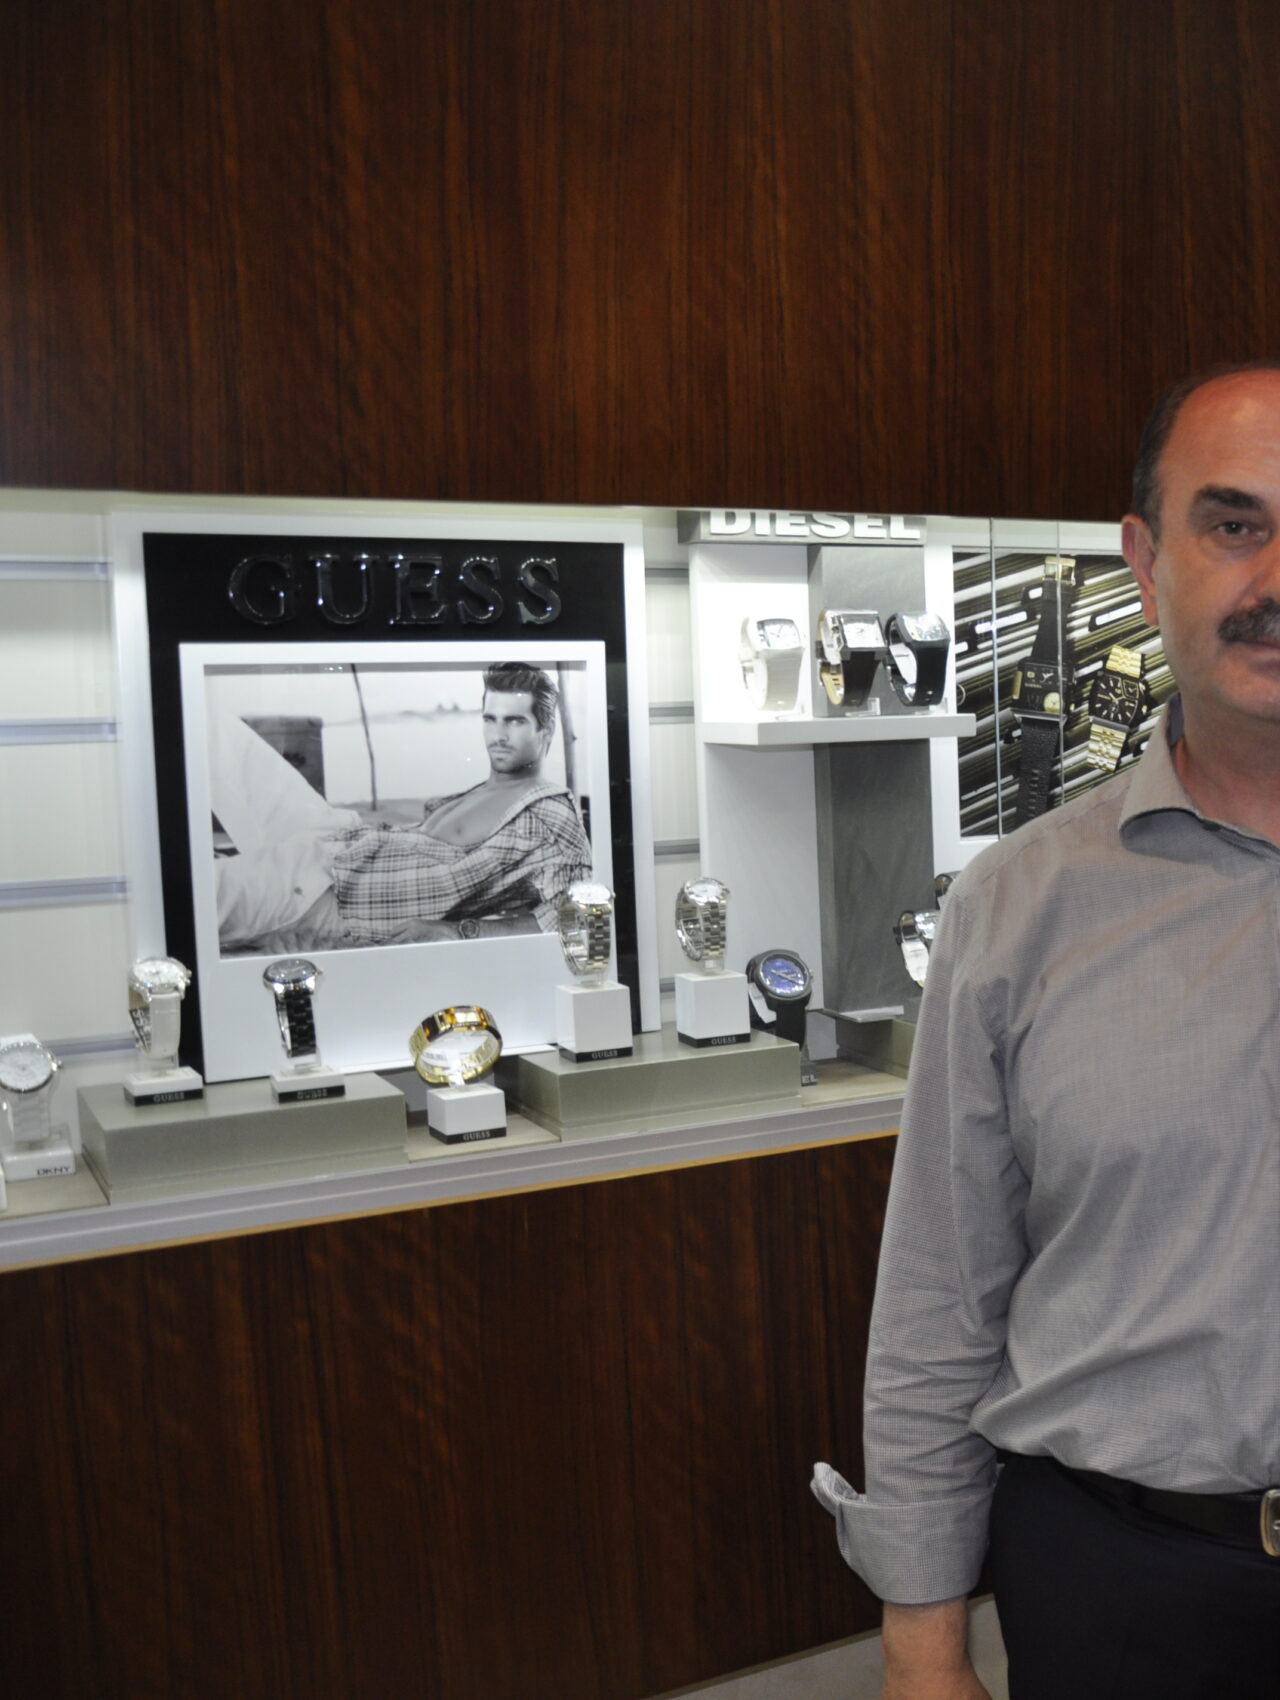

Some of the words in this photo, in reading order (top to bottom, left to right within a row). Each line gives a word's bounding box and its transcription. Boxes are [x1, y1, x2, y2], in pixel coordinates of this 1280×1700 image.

[709, 510, 921, 540] DIESEL
[228, 552, 562, 625] GUESS
[36, 1166, 71, 1177] DKNY
